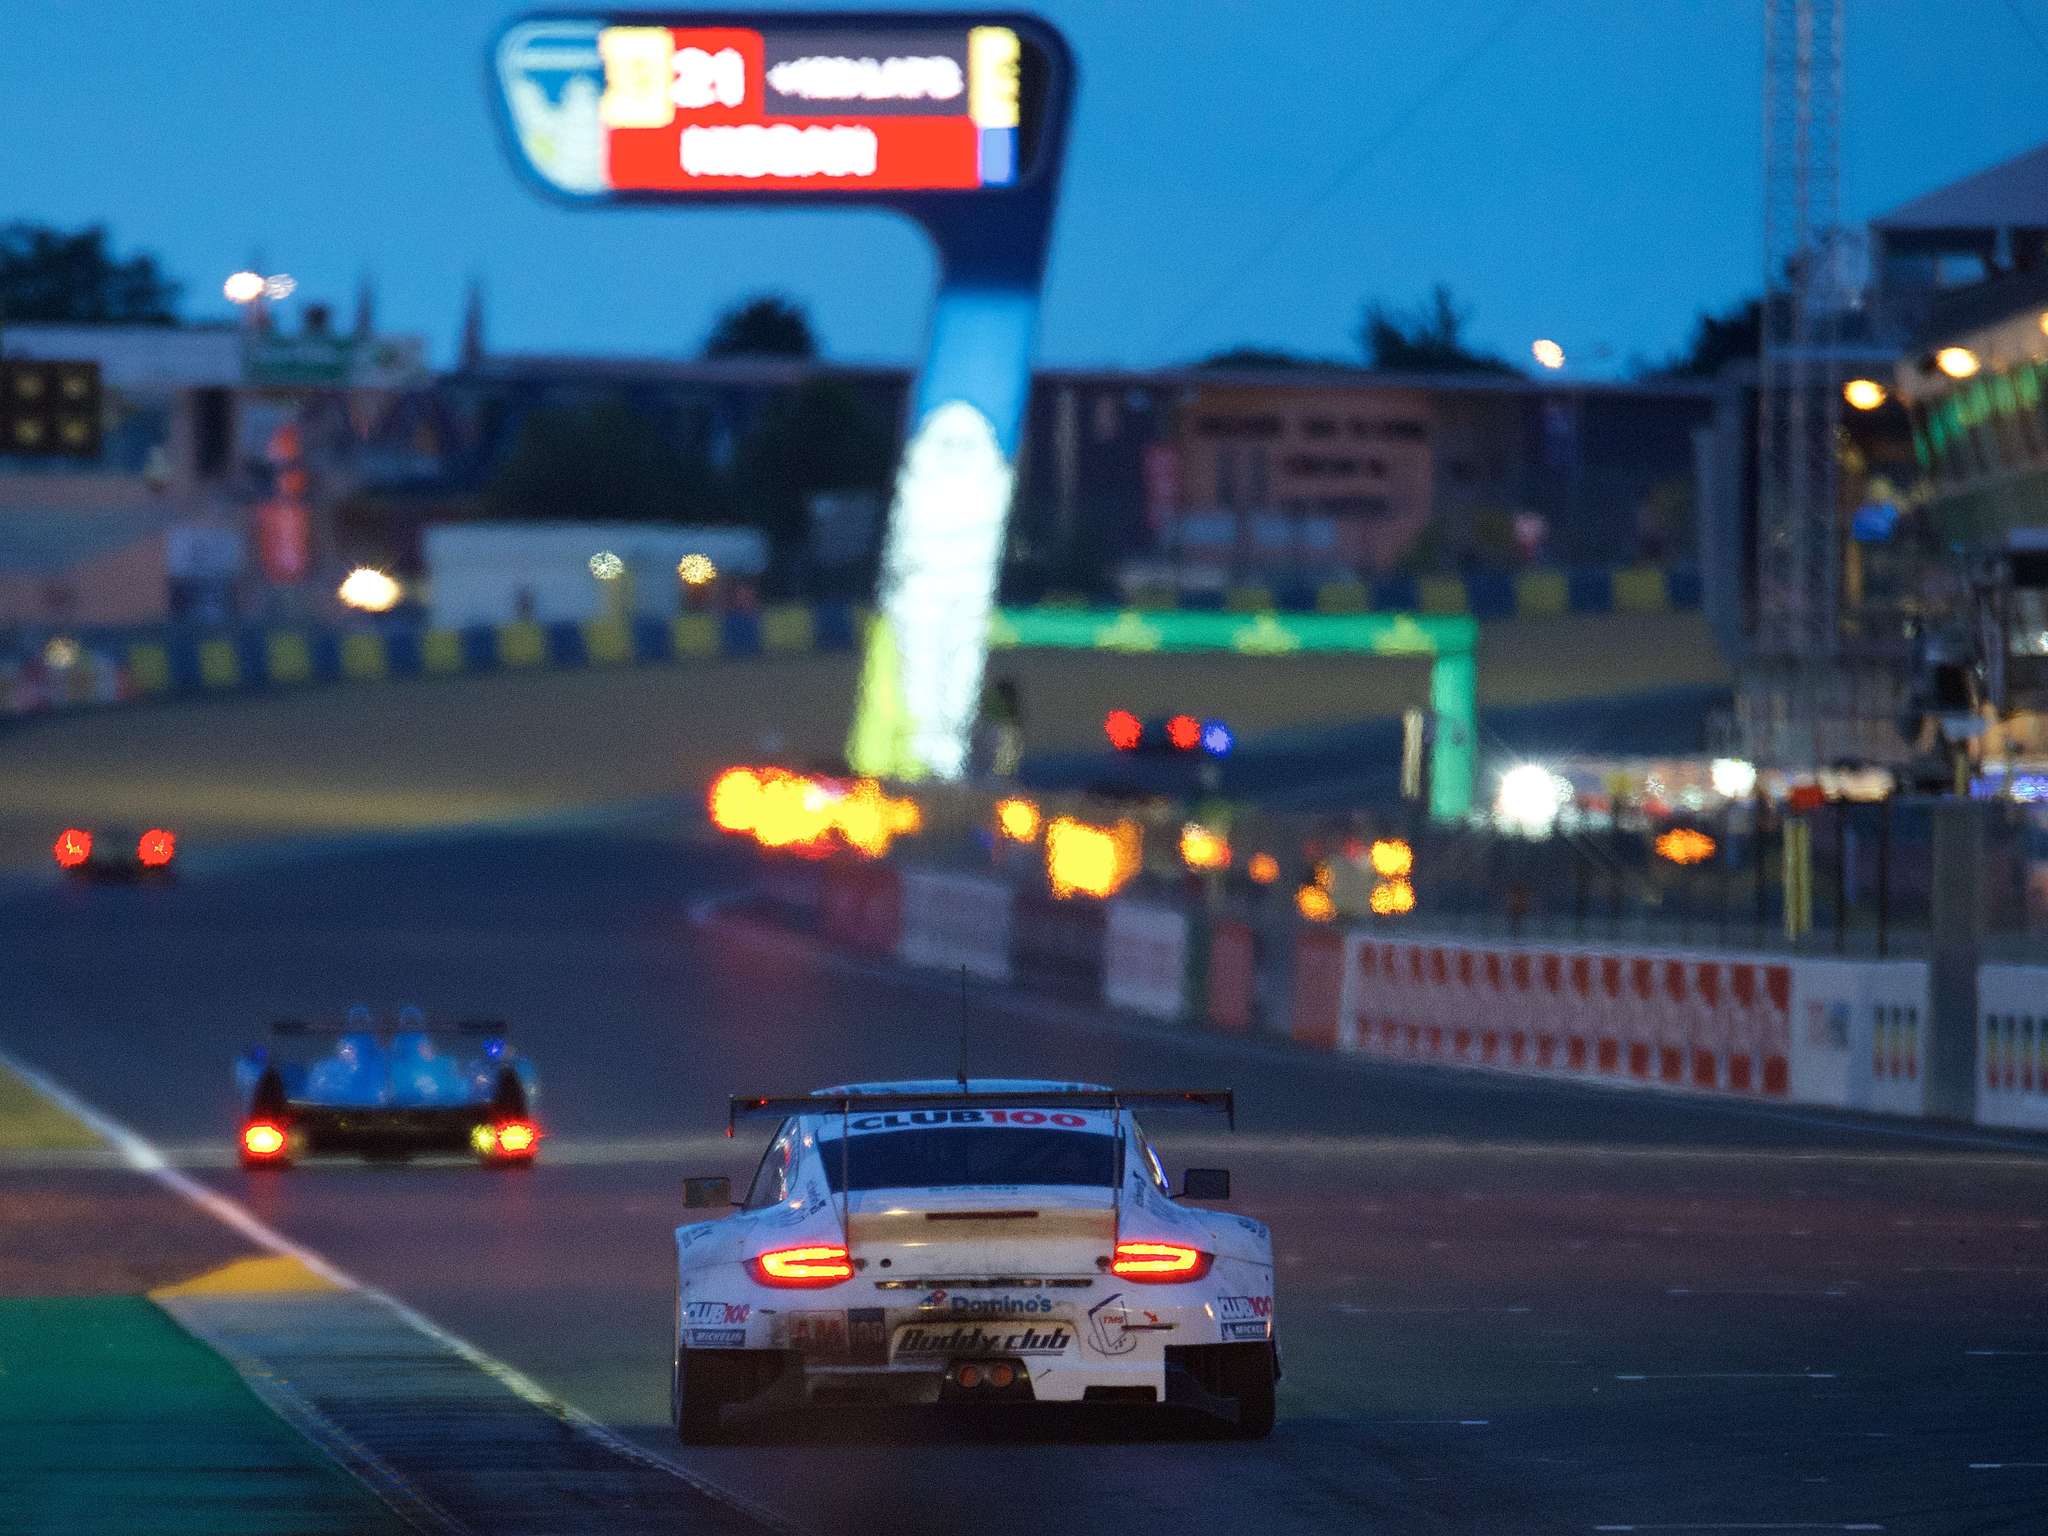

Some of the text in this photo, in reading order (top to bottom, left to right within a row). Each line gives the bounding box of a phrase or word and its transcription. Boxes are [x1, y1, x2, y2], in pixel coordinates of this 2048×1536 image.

[851, 1109, 1087, 1131] CLUB100
[951, 1294, 1052, 1313] Domino's
[1004, 1327, 1070, 1350] club
